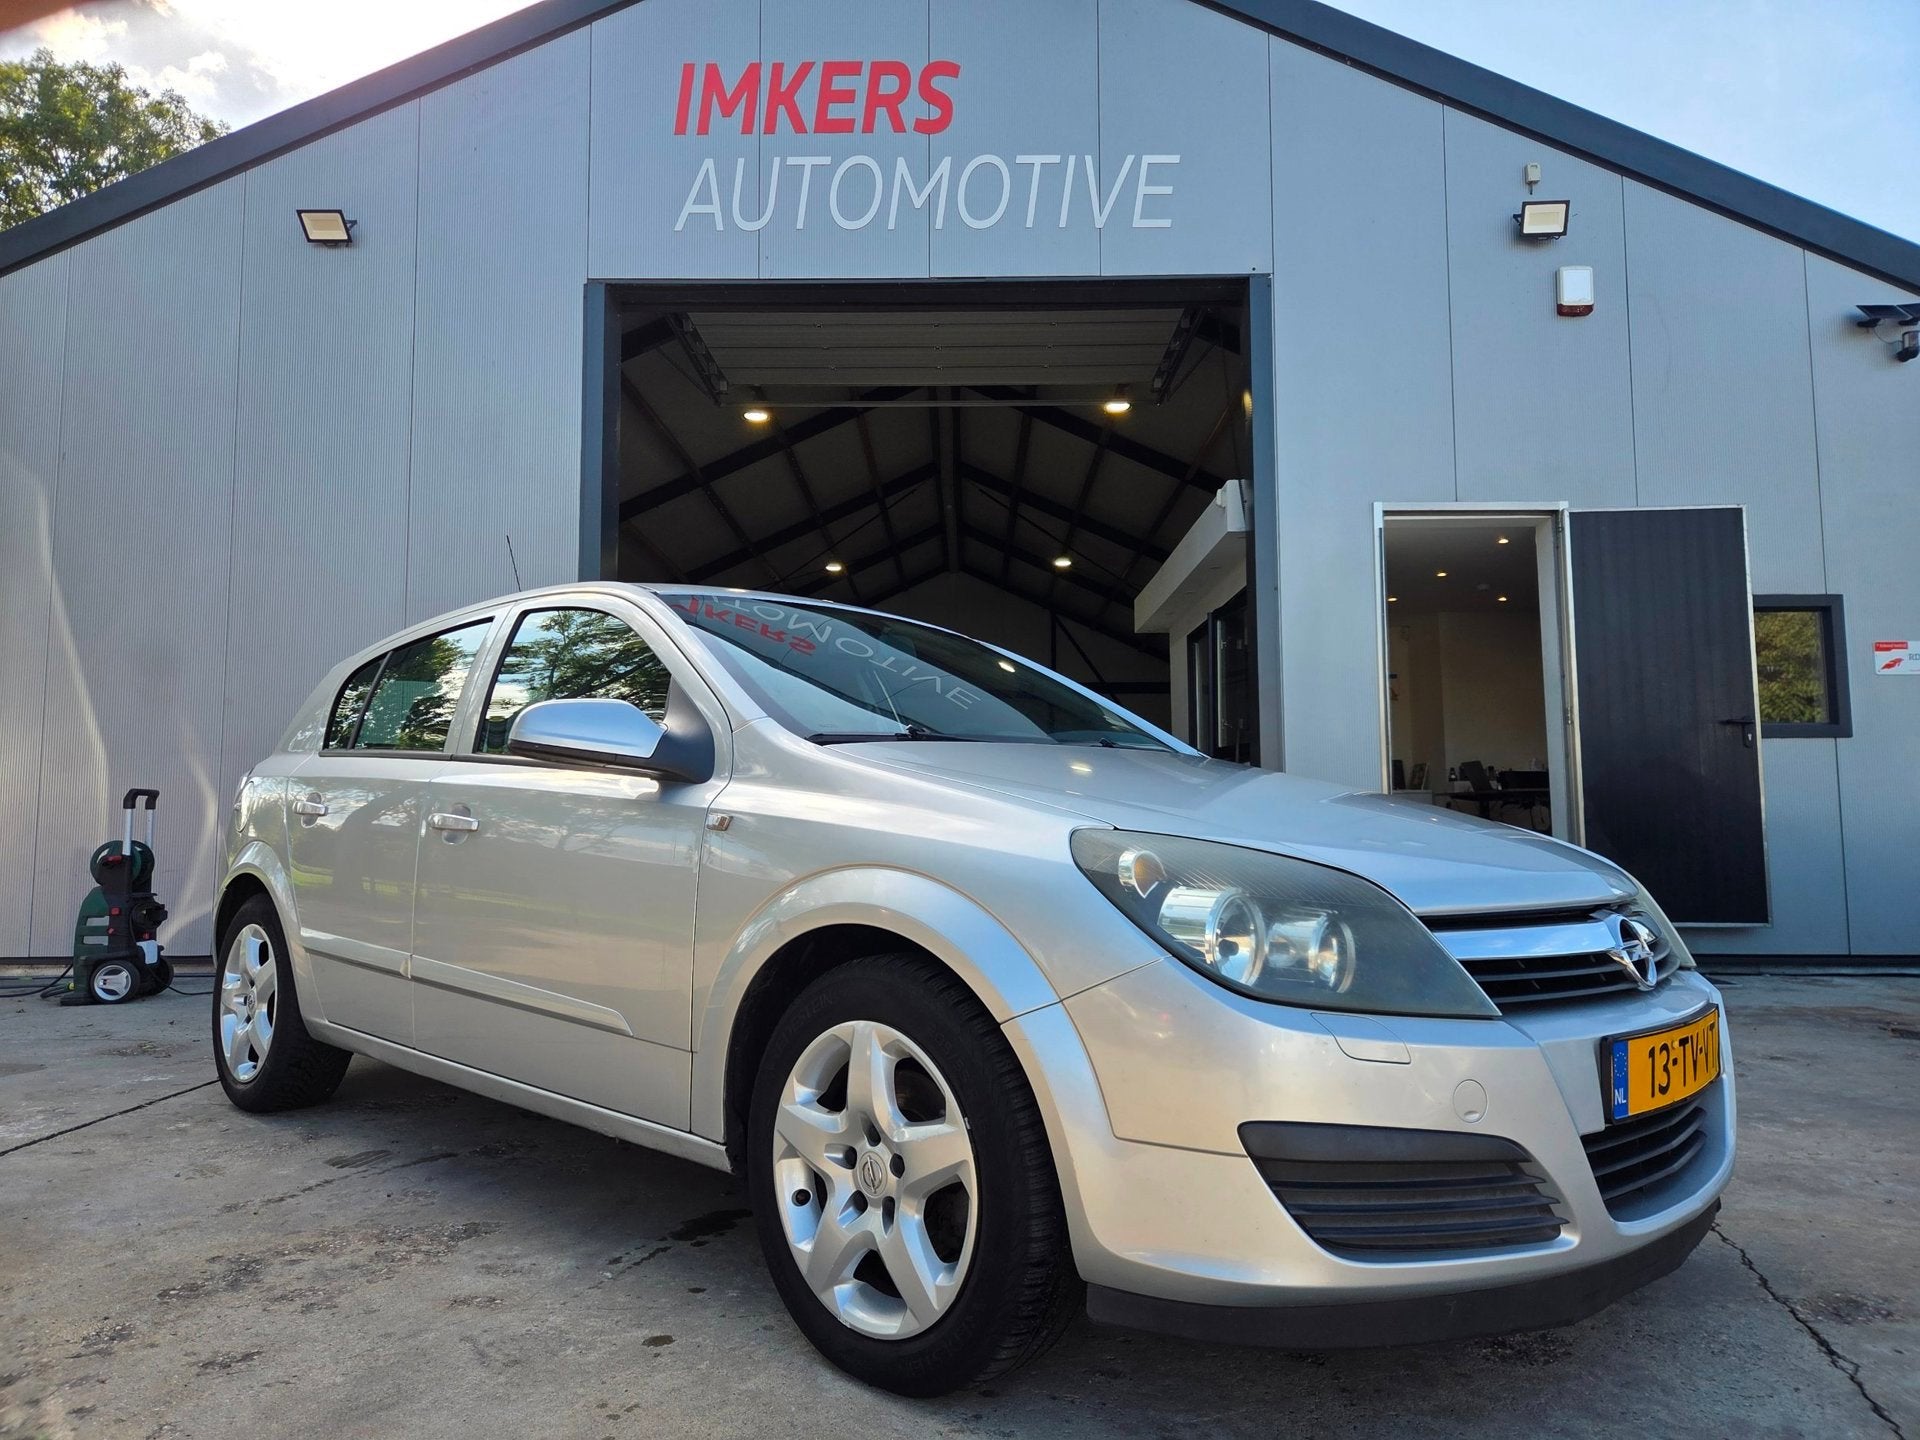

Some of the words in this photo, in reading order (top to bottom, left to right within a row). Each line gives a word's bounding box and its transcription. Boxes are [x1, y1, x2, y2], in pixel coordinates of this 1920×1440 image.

[673, 60, 961, 136] IMKERS
[674, 154, 1181, 232] AUTOMOTIVE
[1614, 1087, 1627, 1106] NL
[1648, 1021, 1716, 1099] 13-TV-VT
